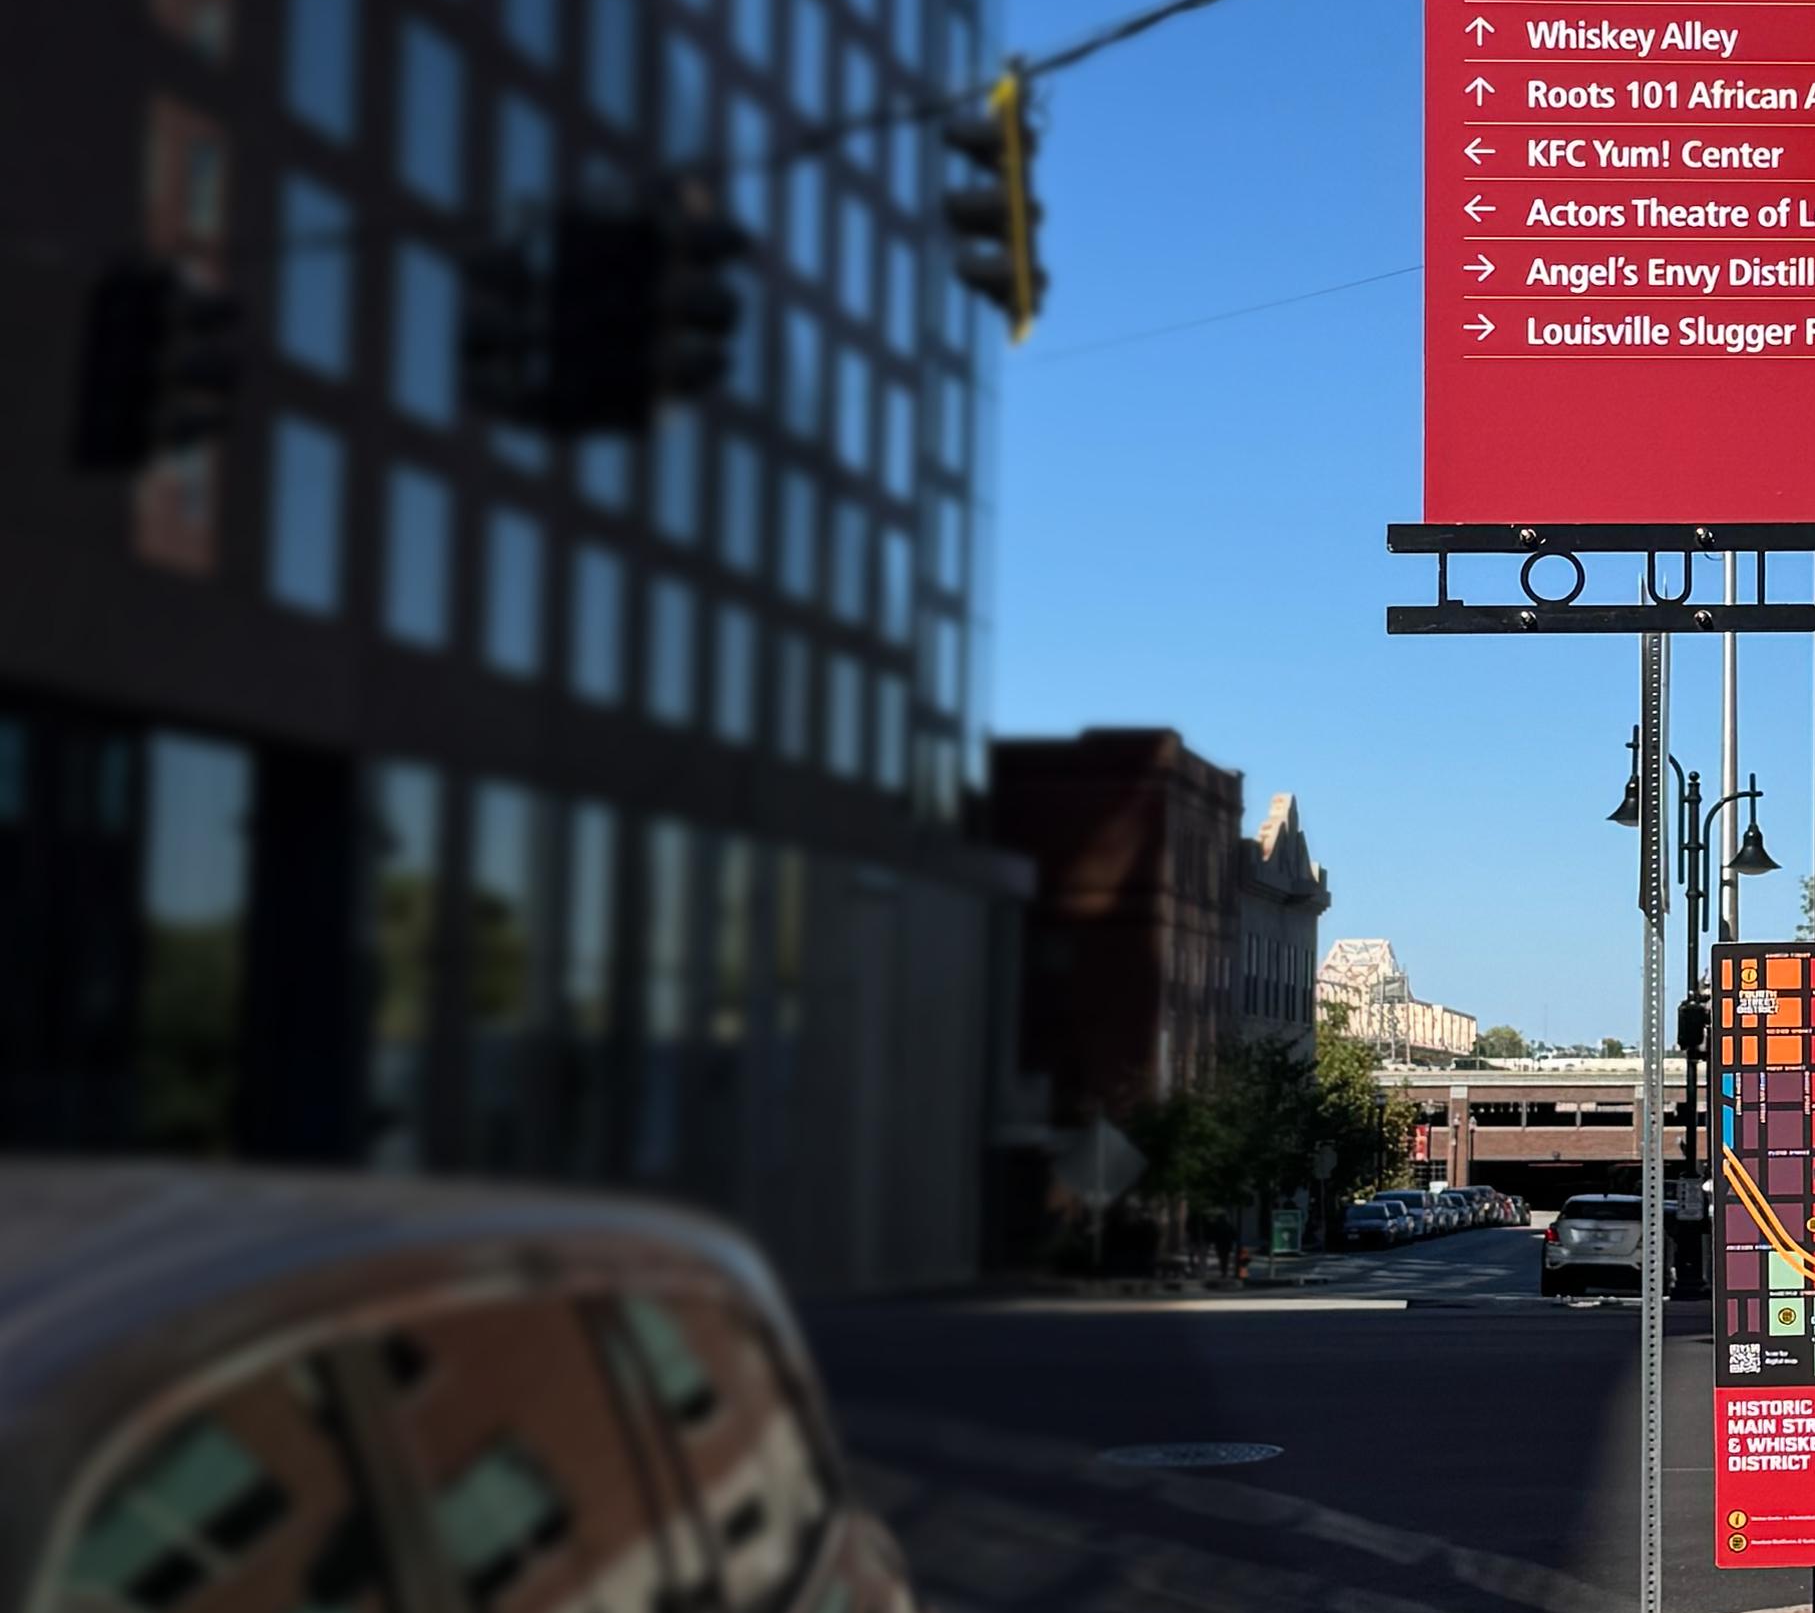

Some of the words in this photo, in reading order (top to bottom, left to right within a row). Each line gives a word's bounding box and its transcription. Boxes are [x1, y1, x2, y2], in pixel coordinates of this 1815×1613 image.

[1526, 19, 1656, 58] Whiskey
[1660, 20, 1739, 59] Alley
[1527, 80, 1616, 109] Roots
[1626, 80, 1678, 109] 101
[1687, 79, 1798, 110] African
[1527, 139, 1586, 168] KFC
[1592, 139, 1670, 168] Yum!
[1681, 139, 1785, 169] Center
[1525, 198, 1626, 227] Actors
[1631, 197, 1750, 228] Theatre
[1757, 197, 1792, 228] of
[1525, 256, 1639, 294] Angel’s
[1648, 258, 1721, 294] Envy
[1527, 314, 1670, 346] Louisville
[1678, 315, 1797, 354] Slugger
[1727, 1399, 1813, 1417] HISTORIC
[1727, 1418, 1776, 1435] MAIN
[1727, 1437, 1741, 1453] &
[1727, 1454, 1811, 1472] DISTRICT
